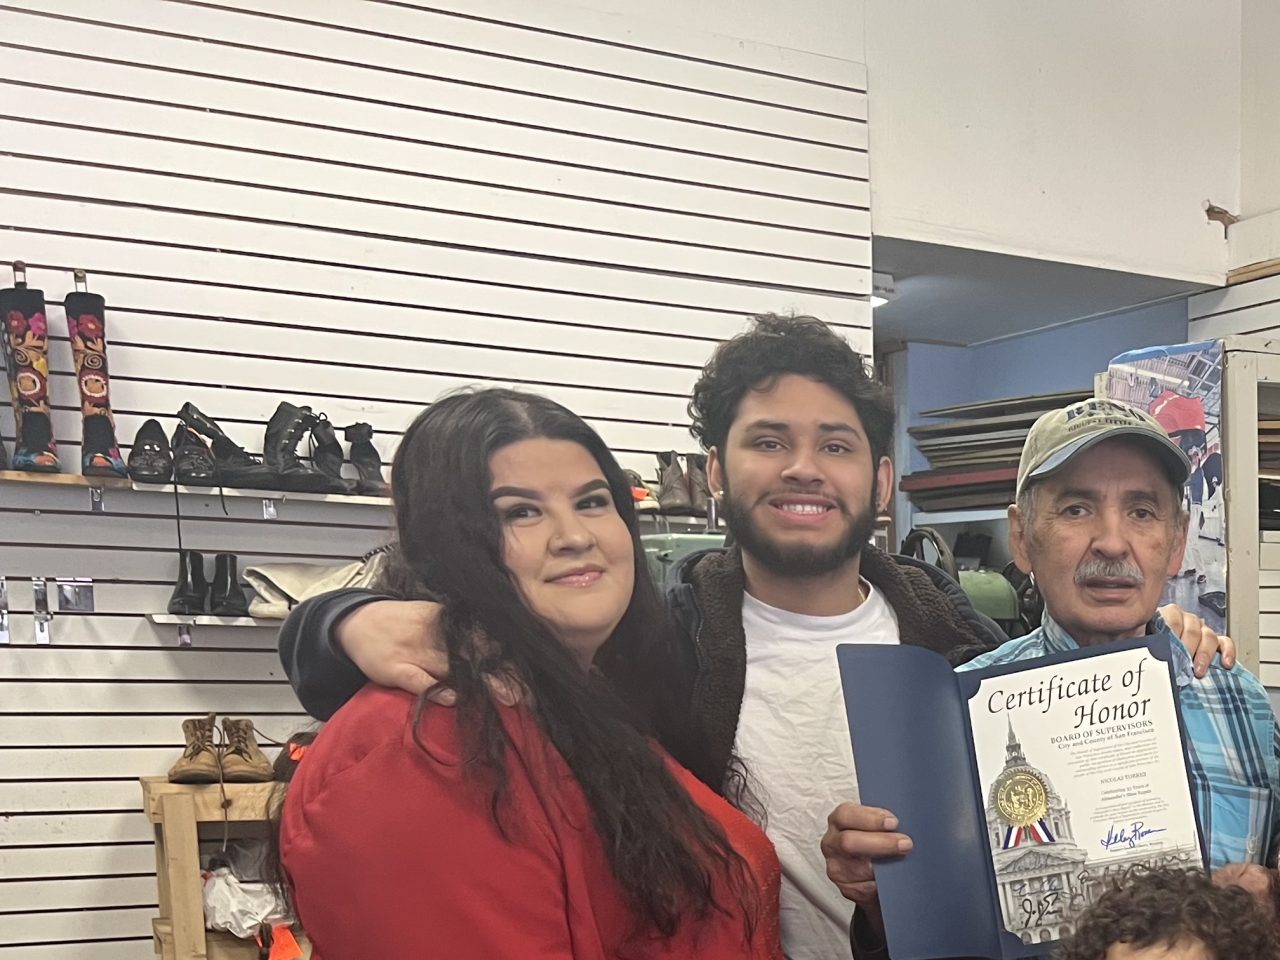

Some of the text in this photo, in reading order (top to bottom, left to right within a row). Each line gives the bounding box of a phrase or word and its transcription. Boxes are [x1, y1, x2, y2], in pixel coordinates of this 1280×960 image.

[988, 657, 1148, 714] Certificate of
[1073, 698, 1152, 729] Honor
[1050, 720, 1153, 744] BOARD OF SUPERVISORS
[1057, 741, 1070, 750] City
[1072, 739, 1084, 747] and
[1084, 735, 1106, 746] County
[1114, 732, 1126, 740] San
[1126, 727, 1155, 738] Francisco
